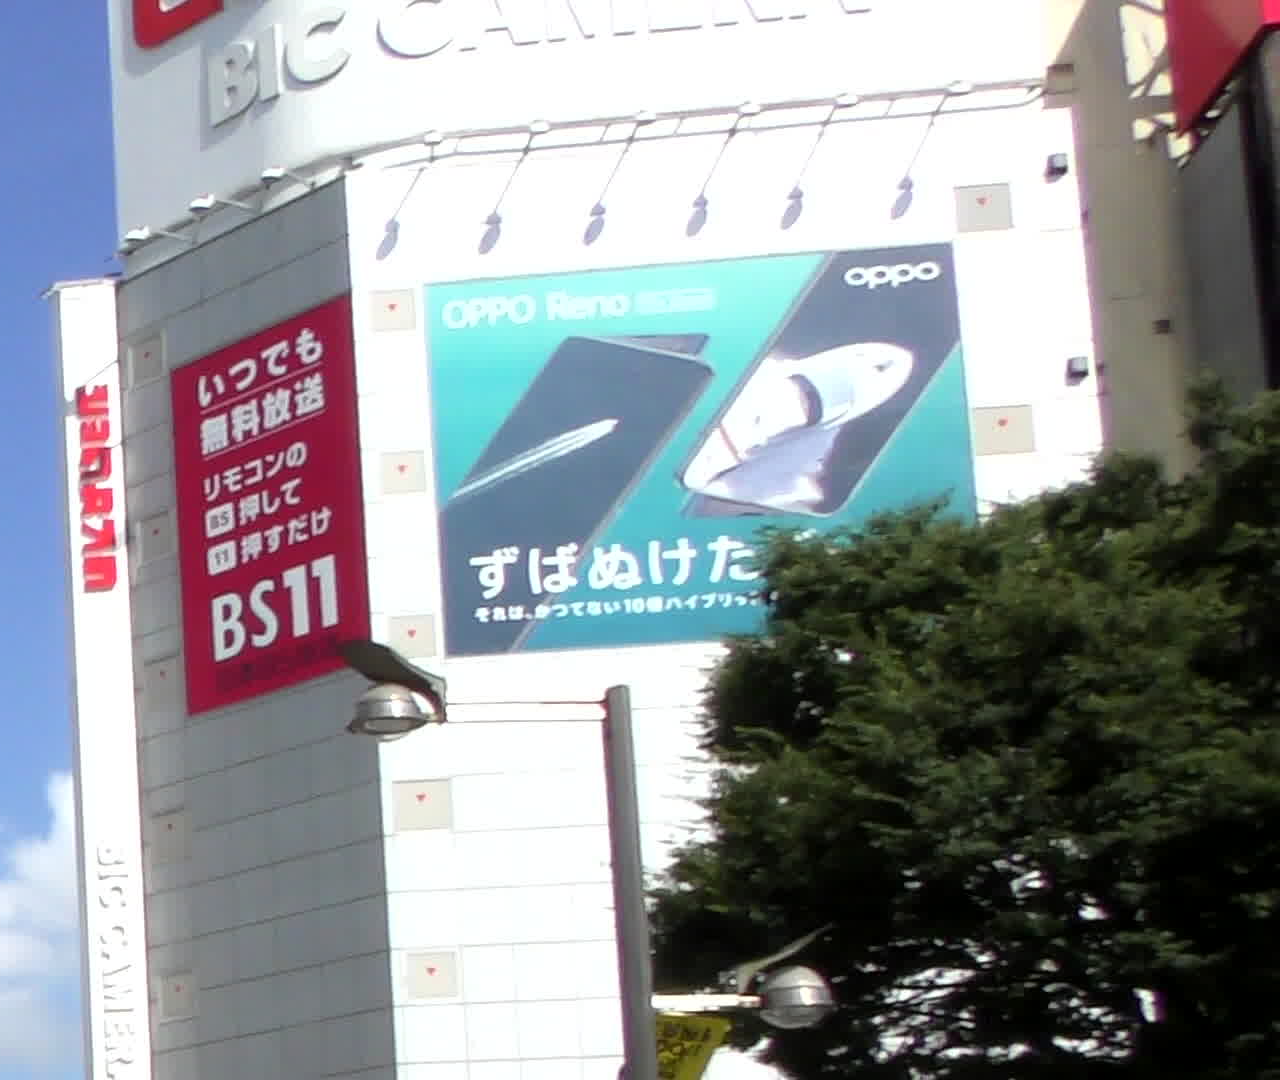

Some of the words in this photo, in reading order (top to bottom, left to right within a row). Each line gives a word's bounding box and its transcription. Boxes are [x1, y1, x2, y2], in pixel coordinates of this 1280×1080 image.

[207, 10, 349, 128] BIC
[442, 294, 536, 330] OPPO
[547, 290, 630, 322] Reno
[196, 328, 325, 407] いつでも
[200, 371, 326, 456] 無料放送
[203, 442, 308, 502] リモコンの
[239, 478, 303, 523] 押して
[240, 508, 333, 563] 押すだけ
[211, 554, 339, 663] BS11
[96, 846, 129, 909] BIC
